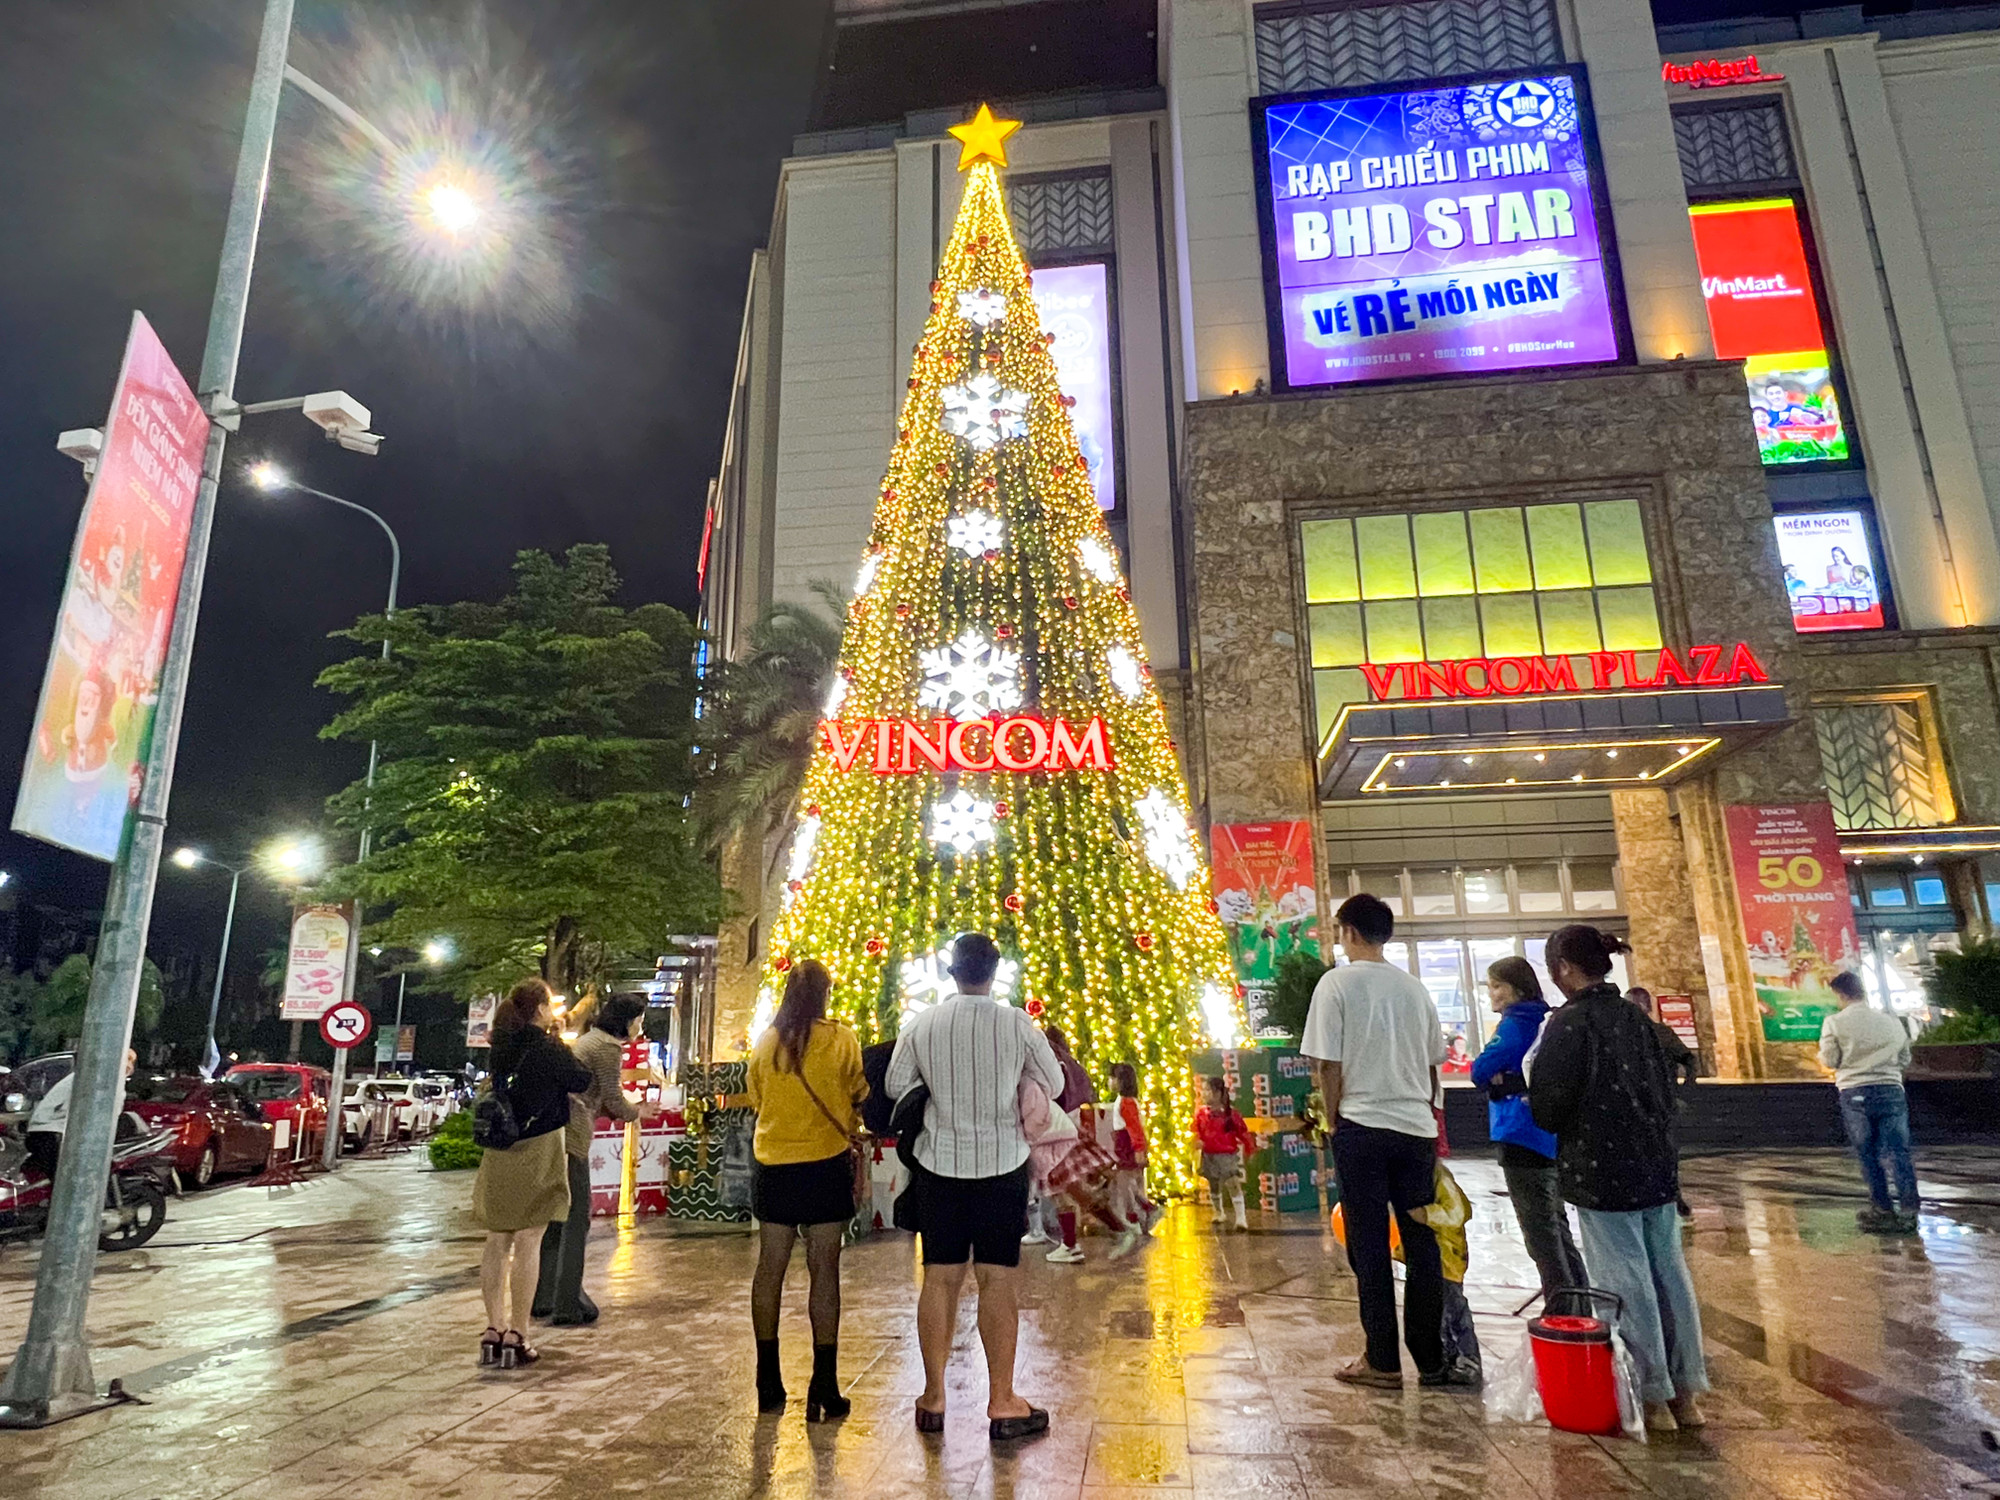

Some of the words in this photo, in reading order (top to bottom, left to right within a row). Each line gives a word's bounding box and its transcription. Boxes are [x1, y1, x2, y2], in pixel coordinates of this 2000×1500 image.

[1287, 160, 1352, 200] RẠP
[1361, 140, 1458, 190] CHIẾU
[1466, 141, 1550, 179] PHIM
[1292, 203, 1413, 262] BHD
[1424, 188, 1577, 249] STAR
[1312, 302, 1352, 336] VÉ
[1352, 279, 1417, 337] RẺ
[1417, 279, 1479, 320] MỖI
[1487, 271, 1560, 310] NGÀY
[1814, 518, 1850, 527] NGON
[1359, 654, 1580, 701] VINCOM
[1588, 643, 1769, 690] PLAZA
[819, 716, 1116, 774] VINCOM
[1760, 808, 1797, 816] VINCOM
[1752, 891, 1787, 903] THỜI
[1787, 892, 1836, 902] TRANG
[1758, 855, 1824, 889] 50
